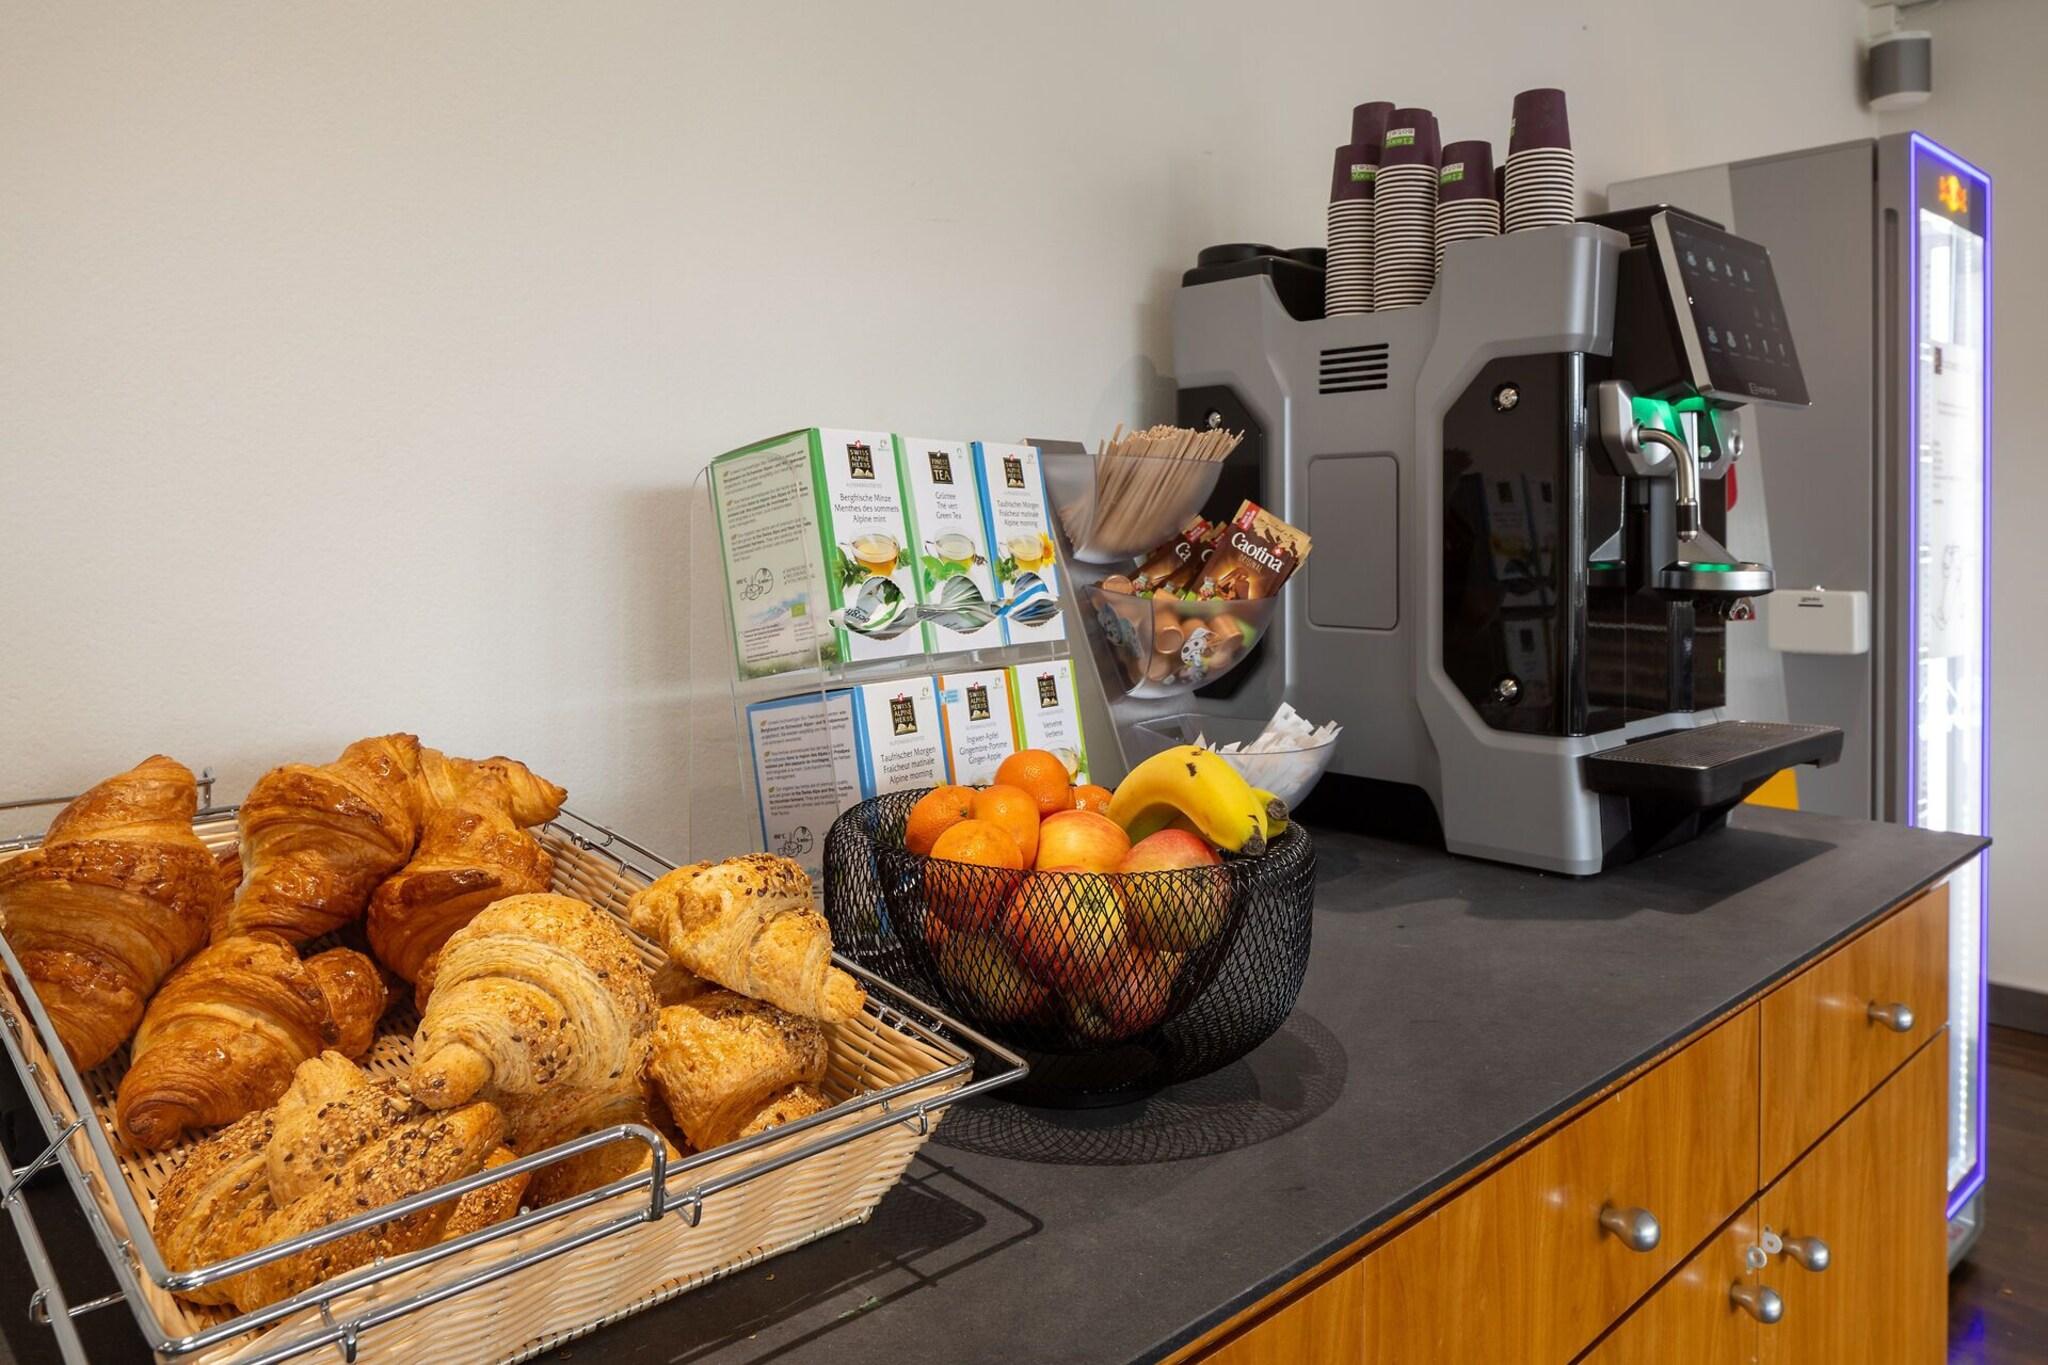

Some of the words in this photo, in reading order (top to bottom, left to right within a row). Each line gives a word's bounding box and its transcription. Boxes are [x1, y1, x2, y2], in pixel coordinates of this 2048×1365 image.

[933, 469, 951, 481] TEA
[834, 504, 861, 513] Menthes
[853, 514, 872, 524] Alpine
[952, 511, 962, 519] Tea
[1231, 531, 1283, 574] Caotina
[892, 702, 912, 711] SWISS
[880, 751, 913, 762] Taufrischer
[913, 747, 936, 757] Morgen
[911, 758, 935, 769] matinale
[889, 774, 909, 785] Alpine
[909, 769, 933, 780] morning
